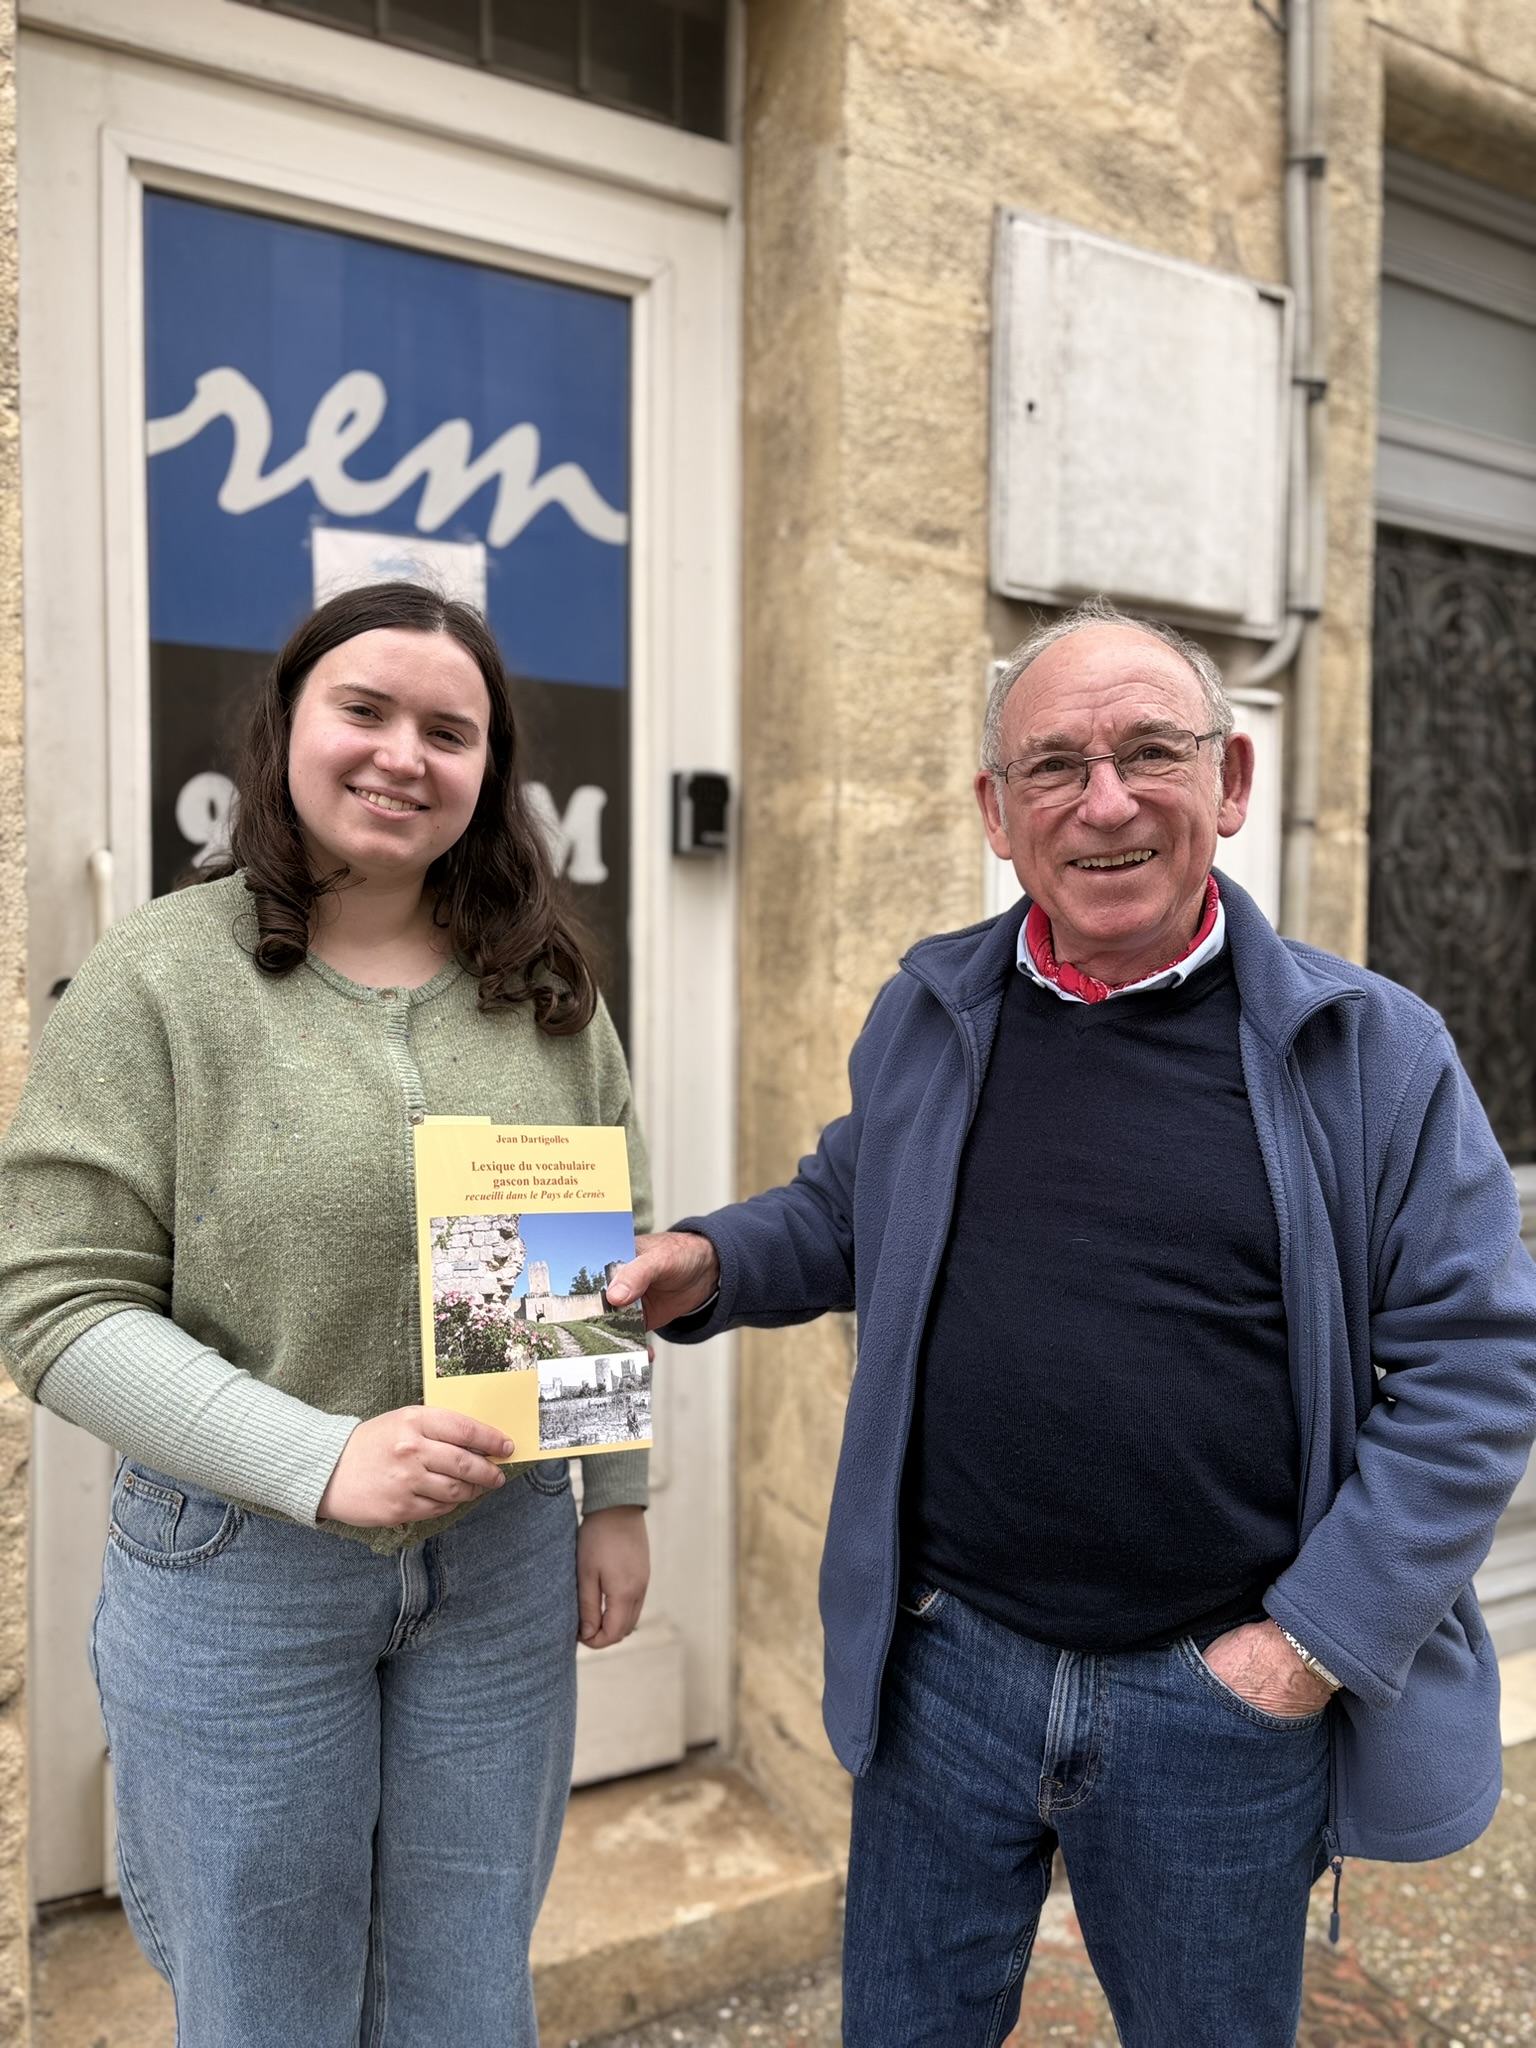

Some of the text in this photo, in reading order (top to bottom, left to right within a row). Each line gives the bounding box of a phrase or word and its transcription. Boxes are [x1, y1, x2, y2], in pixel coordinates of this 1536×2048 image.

[495, 1134, 570, 1146] Jean Dartigolles
[471, 1160, 597, 1174] Lexique du vocabulaire
[493, 1175, 579, 1189] gascon bazadais
[465, 1189, 606, 1202] recueilli dans le Pays de Cernès
